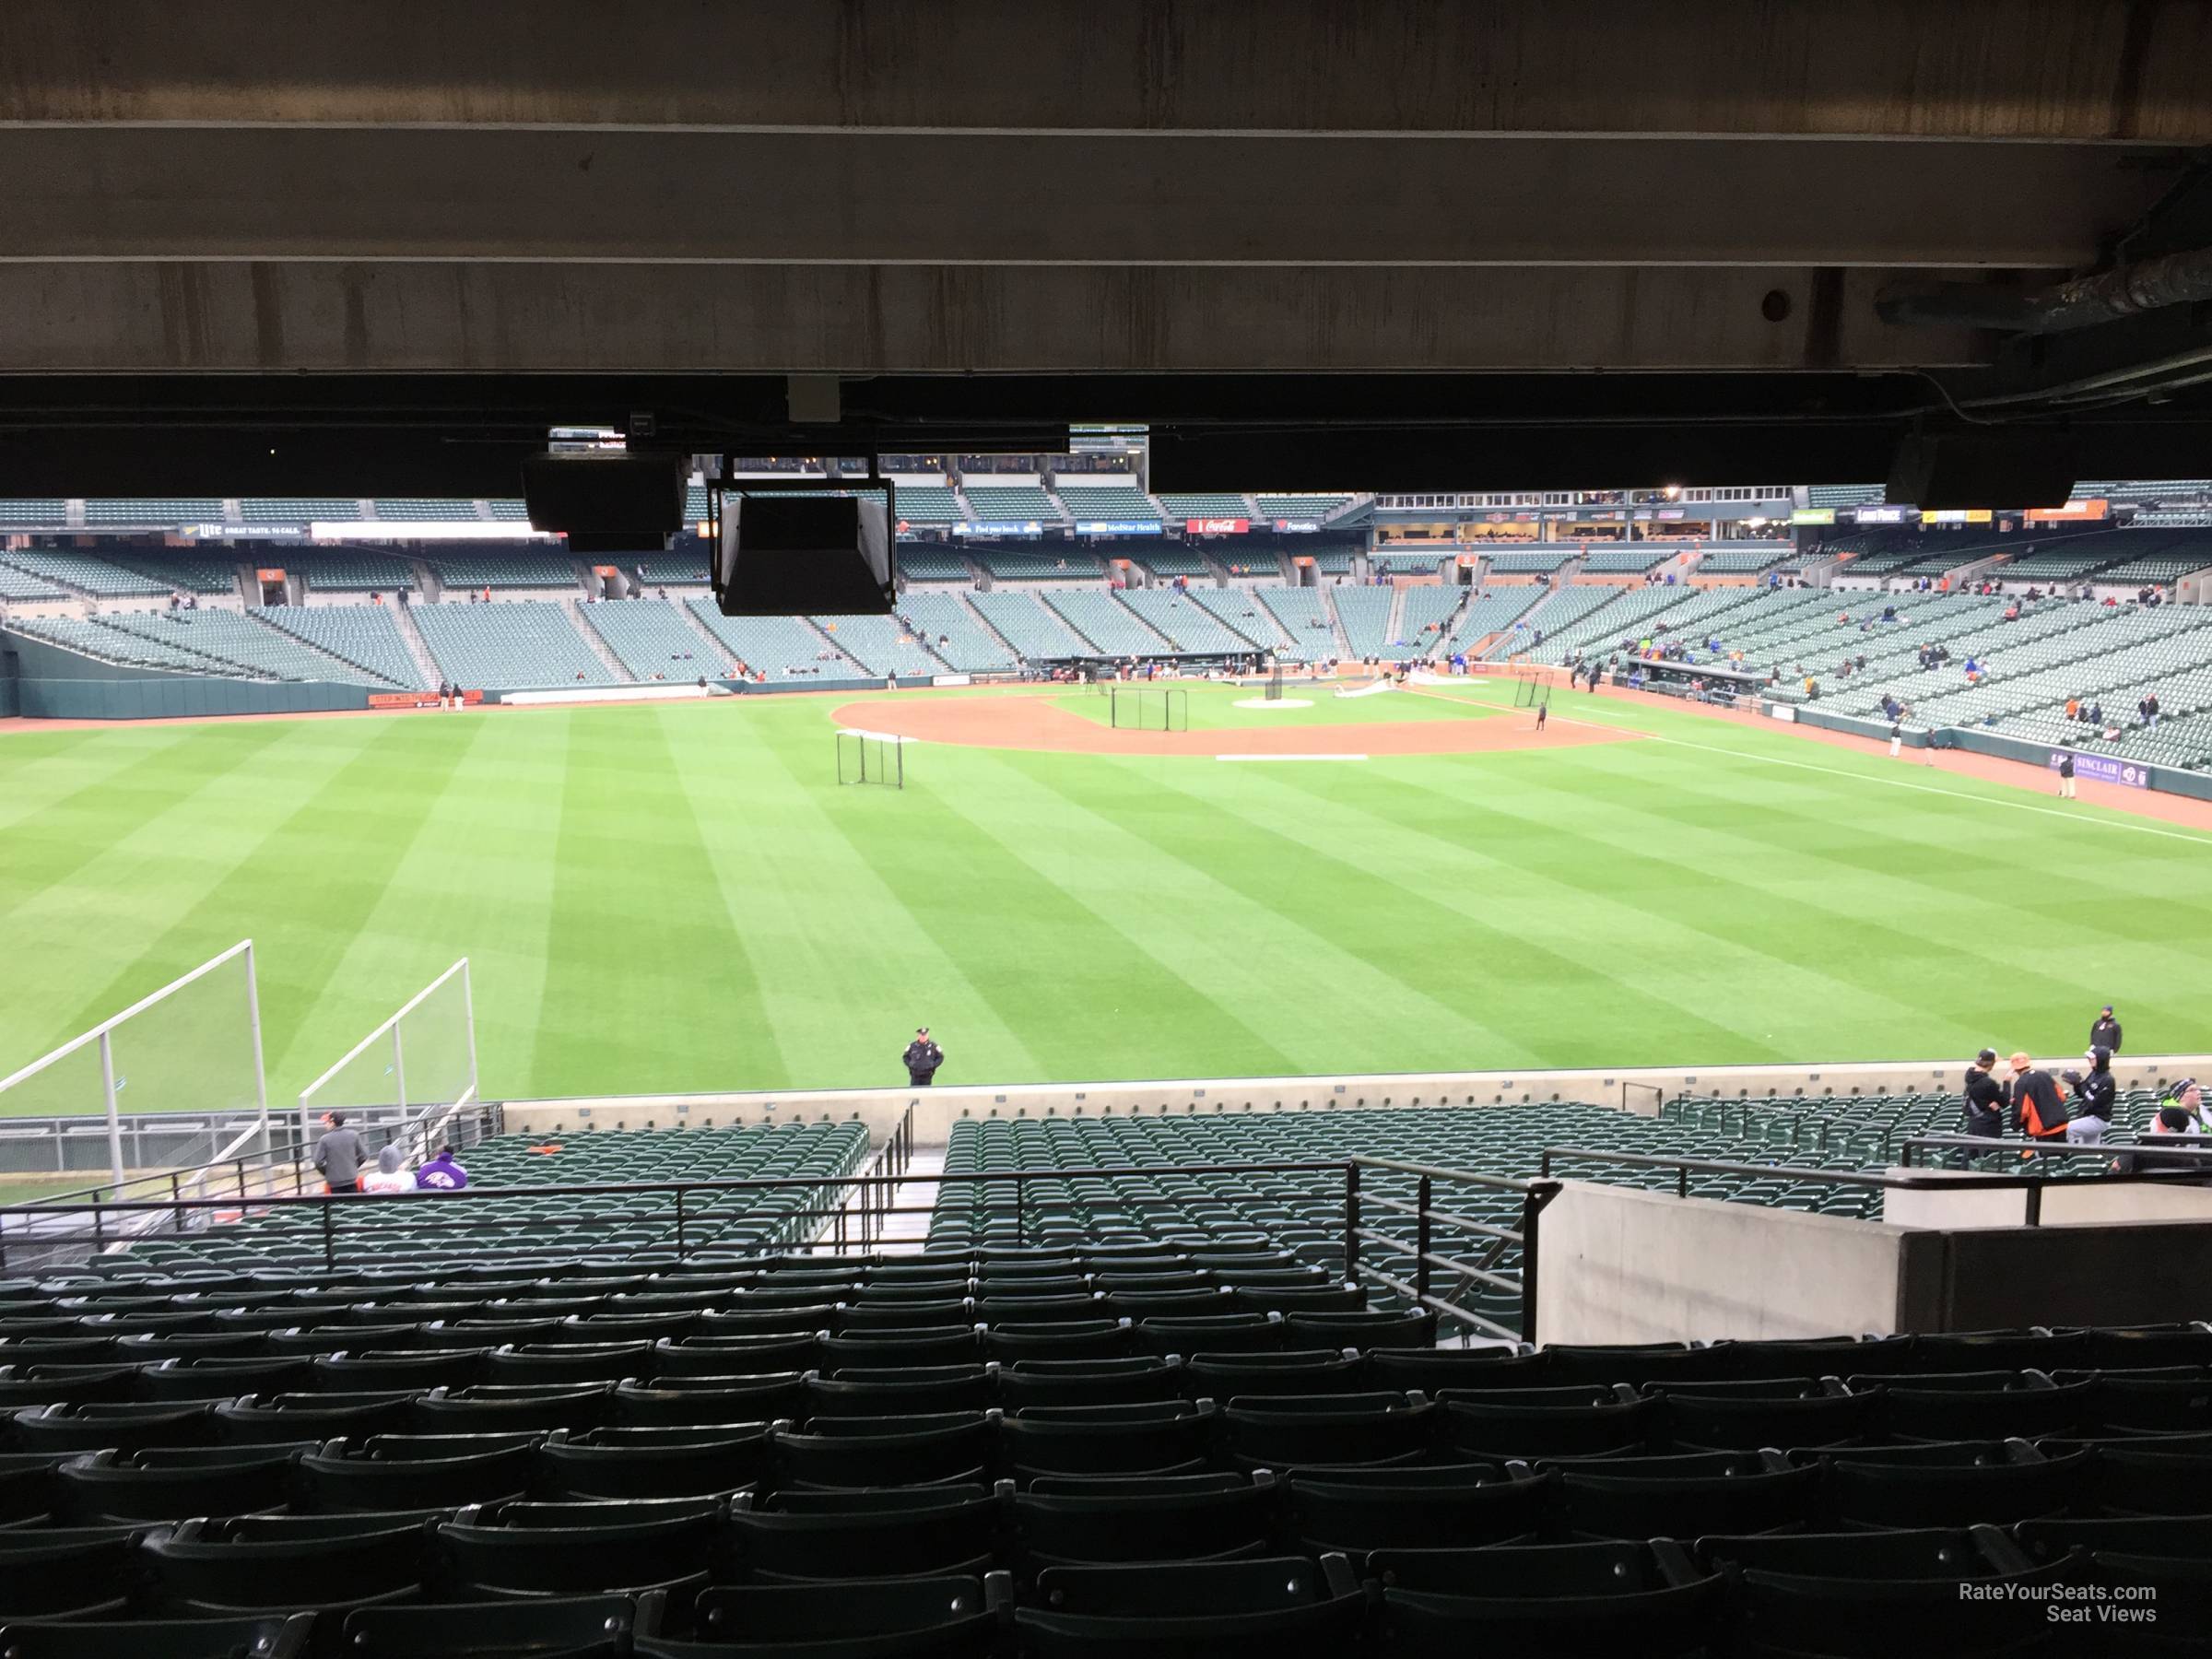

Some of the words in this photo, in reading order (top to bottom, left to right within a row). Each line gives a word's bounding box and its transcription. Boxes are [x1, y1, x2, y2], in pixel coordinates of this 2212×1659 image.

[198, 524, 222, 537] Lite
[224, 526, 247, 535] GREAT
[975, 524, 988, 533] Find
[988, 525, 1002, 535] your
[1107, 523, 1135, 532] MedStar
[1136, 522, 1161, 532] Health
[1287, 522, 1317, 531] Fanatics
[2077, 757, 2118, 775] SINCLAIR
